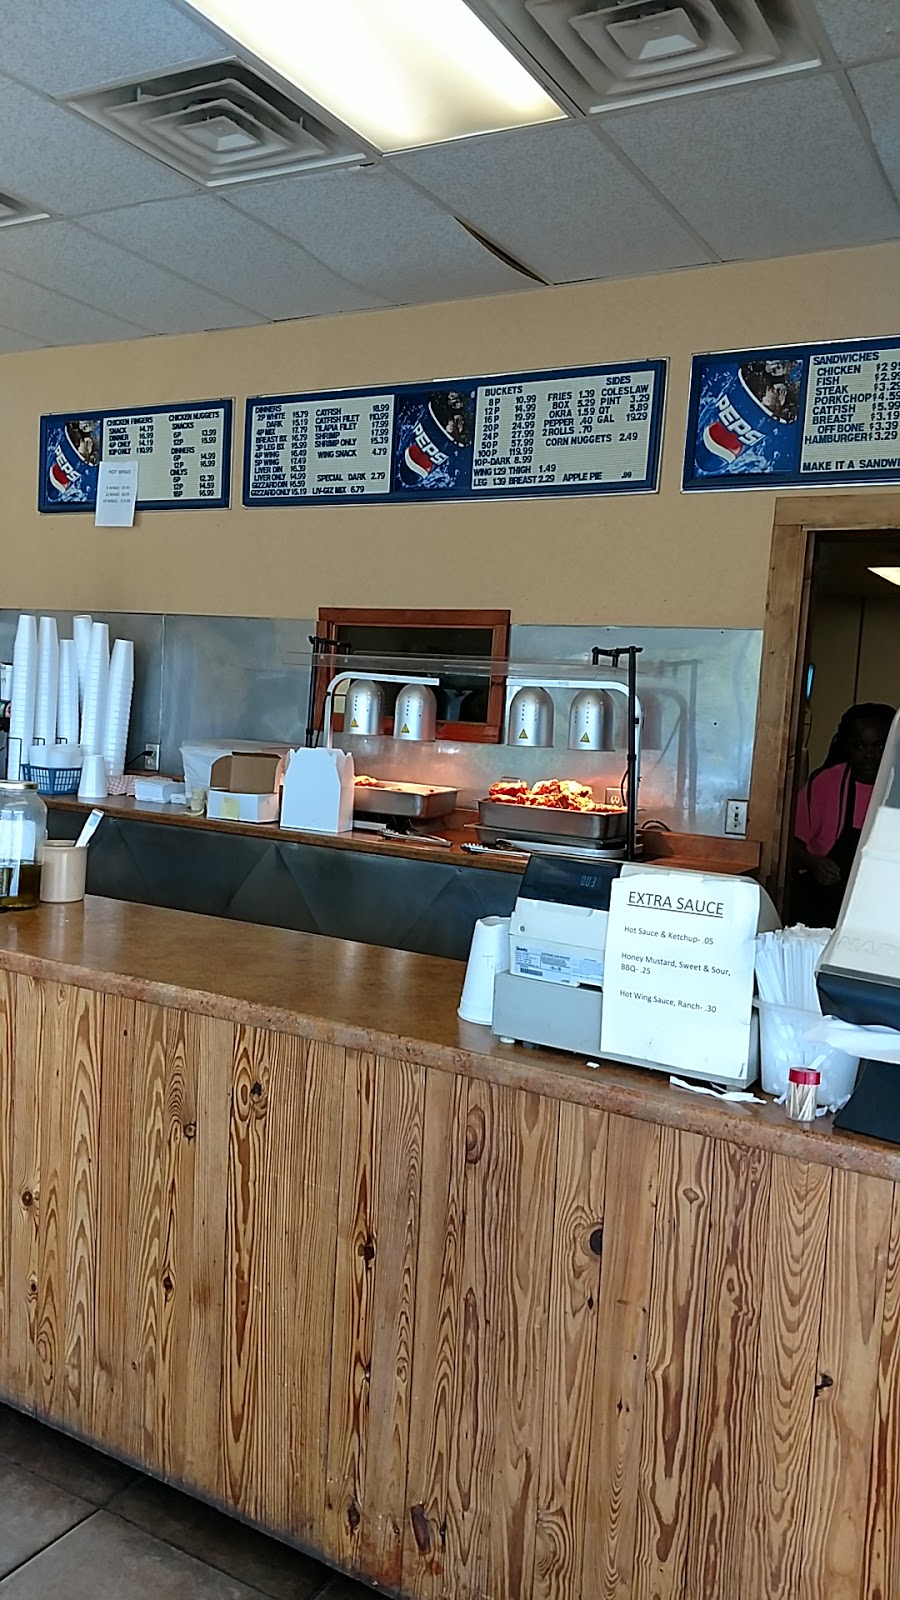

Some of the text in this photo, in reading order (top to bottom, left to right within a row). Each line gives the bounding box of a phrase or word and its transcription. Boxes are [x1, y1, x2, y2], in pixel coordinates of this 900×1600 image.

[813, 352, 880, 365] SANDWICHES
[817, 365, 861, 376] CHICKEN
[606, 376, 631, 385] SIDES
[816, 376, 840, 386] FISH
[485, 386, 523, 396] BUCKETS
[547, 390, 595, 401] FRIES 1.39
[601, 385, 649, 396] COLESLAW
[816, 385, 848, 396] STEAK
[516, 395, 536, 404] 10.99
[552, 401, 569, 409] BOX
[600, 394, 650, 405] PINT 3.29
[255, 405, 282, 413] DINNERS
[515, 404, 536, 412] 14.99
[549, 408, 595, 418] OKRA 1.59
[598, 406, 610, 414] QT
[813, 402, 900, 415] CATFISH $5.99
[168, 411, 219, 422] CHICKEN NUGGETS
[514, 413, 535, 421] 19.99
[597, 415, 614, 423] GAL
[715, 394, 766, 446] PEPS
[812, 411, 900, 425] BREAST $3.19
[512, 421, 535, 430] 24.99
[544, 419, 574, 427] PEPPER
[869, 421, 899, 431] $3.39
[511, 430, 534, 438] 27.99
[548, 427, 574, 436] ROLLS
[511, 439, 534, 447] 57.99
[546, 438, 568, 446] CORN
[571, 434, 612, 444] NUGGETS
[804, 431, 898, 445] HAMBURGER $3.29
[413, 423, 449, 465] PEPS
[54, 445, 81, 482] PEPS
[514, 456, 532, 464] 8.99
[802, 461, 831, 471] MAKE
[836, 461, 845, 469] IT
[847, 460, 854, 469] A
[473, 468, 492, 476] WING
[508, 466, 531, 475] THIGH
[538, 464, 556, 473] 1.49
[371, 472, 385, 480] 2.79
[473, 478, 487, 487] LEG
[508, 476, 537, 484] BREAST
[562, 473, 588, 482] APPLE
[589, 472, 602, 480] PIE
[580, 875, 597, 887] 003
[628, 891, 724, 915] EXTRA SAUCE
[624, 925, 637, 934] Hot
[638, 928, 659, 937] Sauce
[668, 933, 701, 943] Ketchup-
[621, 953, 644, 963] Honey
[645, 956, 677, 968] Mustard,
[679, 962, 701, 971] Sweet
[711, 967, 731, 976] Sour,
[621, 964, 638, 973] BBQ-
[619, 990, 716, 1013] Hot Wing Sauce, Ranch- .30
